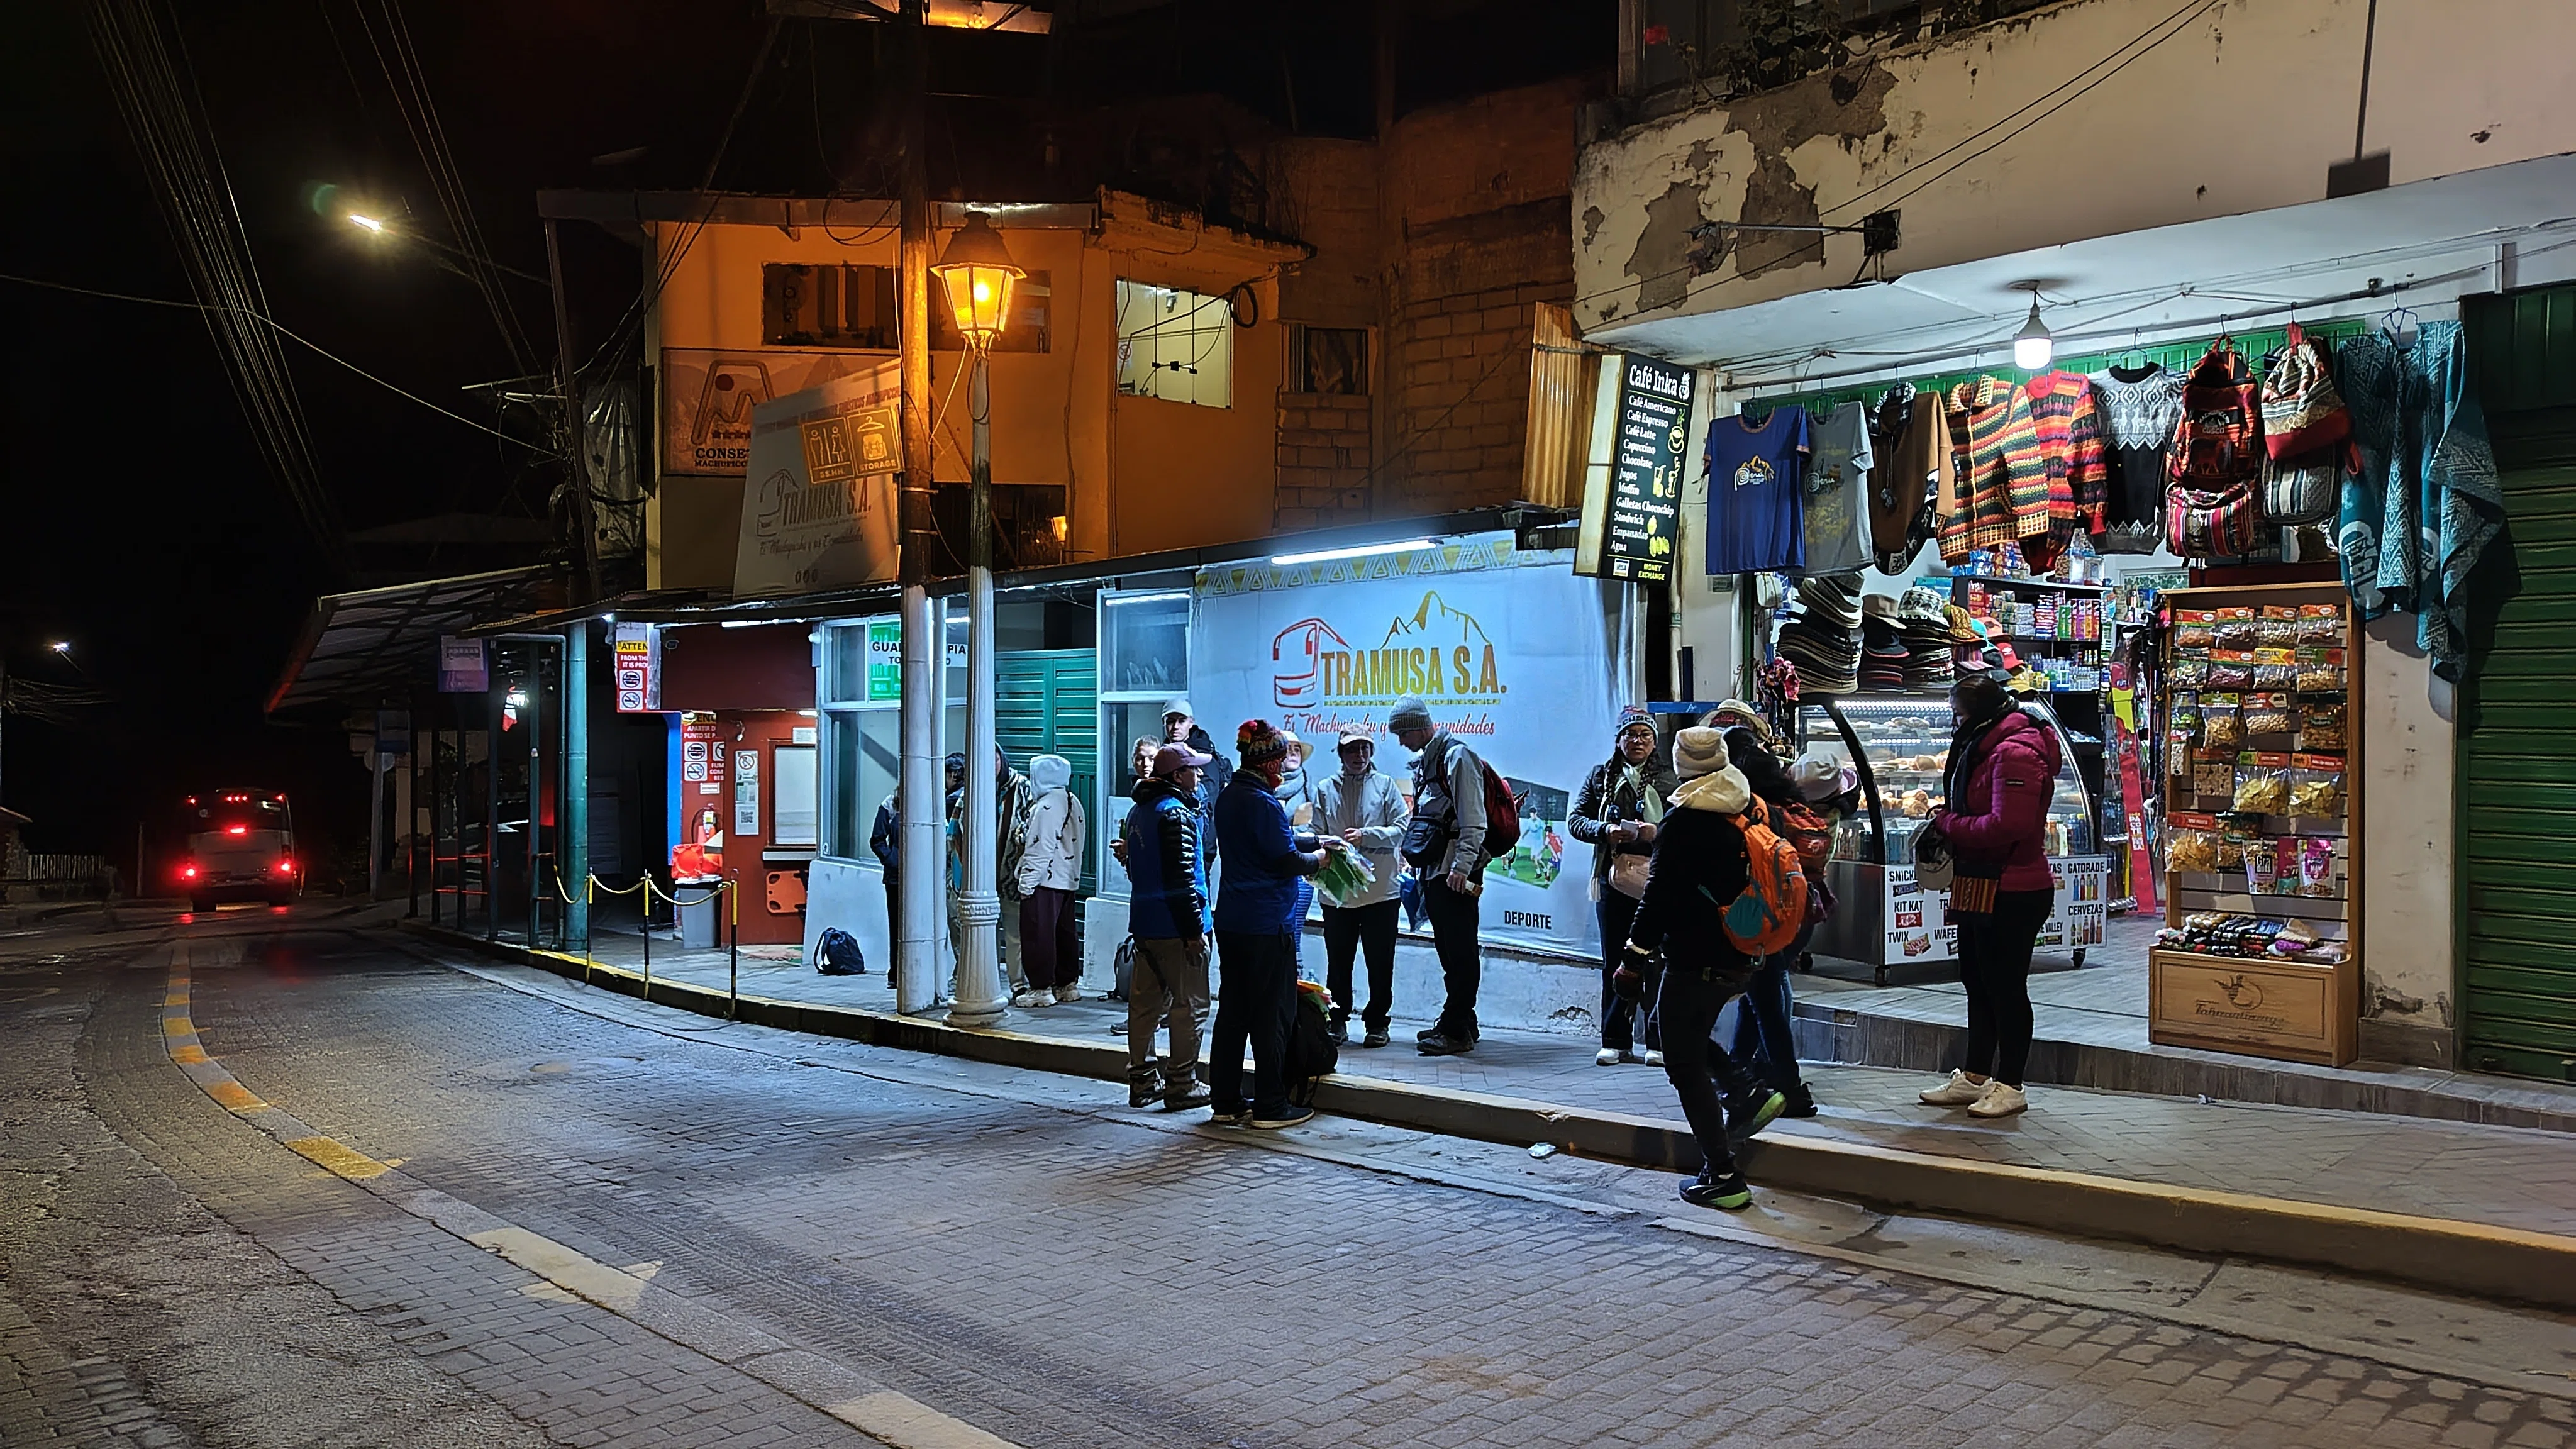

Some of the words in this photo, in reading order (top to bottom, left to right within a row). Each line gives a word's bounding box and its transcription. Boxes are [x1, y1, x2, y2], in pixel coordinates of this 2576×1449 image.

[1629, 365, 1653, 389] Café
[1653, 370, 1677, 396] Inka
[1629, 395, 1643, 408] Café
[1643, 399, 1676, 415] Americano
[1627, 410, 1641, 422] Café
[1641, 413, 1668, 428] Espresso
[1626, 424, 1640, 436] Café
[1640, 427, 1657, 440] Latte
[695, 448, 750, 459] CONSE
[1624, 439, 1656, 455] Capuccino
[859, 459, 896, 472] STORAGE
[1622, 453, 1653, 469] Chocolate
[1619, 468, 1637, 481] Jugos
[1618, 482, 1640, 495] Muffin
[1616, 496, 1641, 511] Galletas
[1614, 511, 1644, 525] Sandwich
[1613, 526, 1648, 540] Empanadas
[1611, 540, 1627, 553] Agua
[872, 642, 901, 652] GUA
[1321, 647, 1444, 696] TRAMUSA
[1453, 644, 1507, 694] S.A.
[2068, 862, 2105, 874] GATORADE
[1889, 870, 1916, 882] SNICK
[1894, 901, 1907, 912] KIT
[1909, 901, 1923, 912] KAT
[2068, 904, 2103, 916] CERVEZAS
[1504, 910, 1552, 930] DEPORTE
[2045, 921, 2063, 933] VALLEY
[1888, 931, 1908, 943] TWIX
